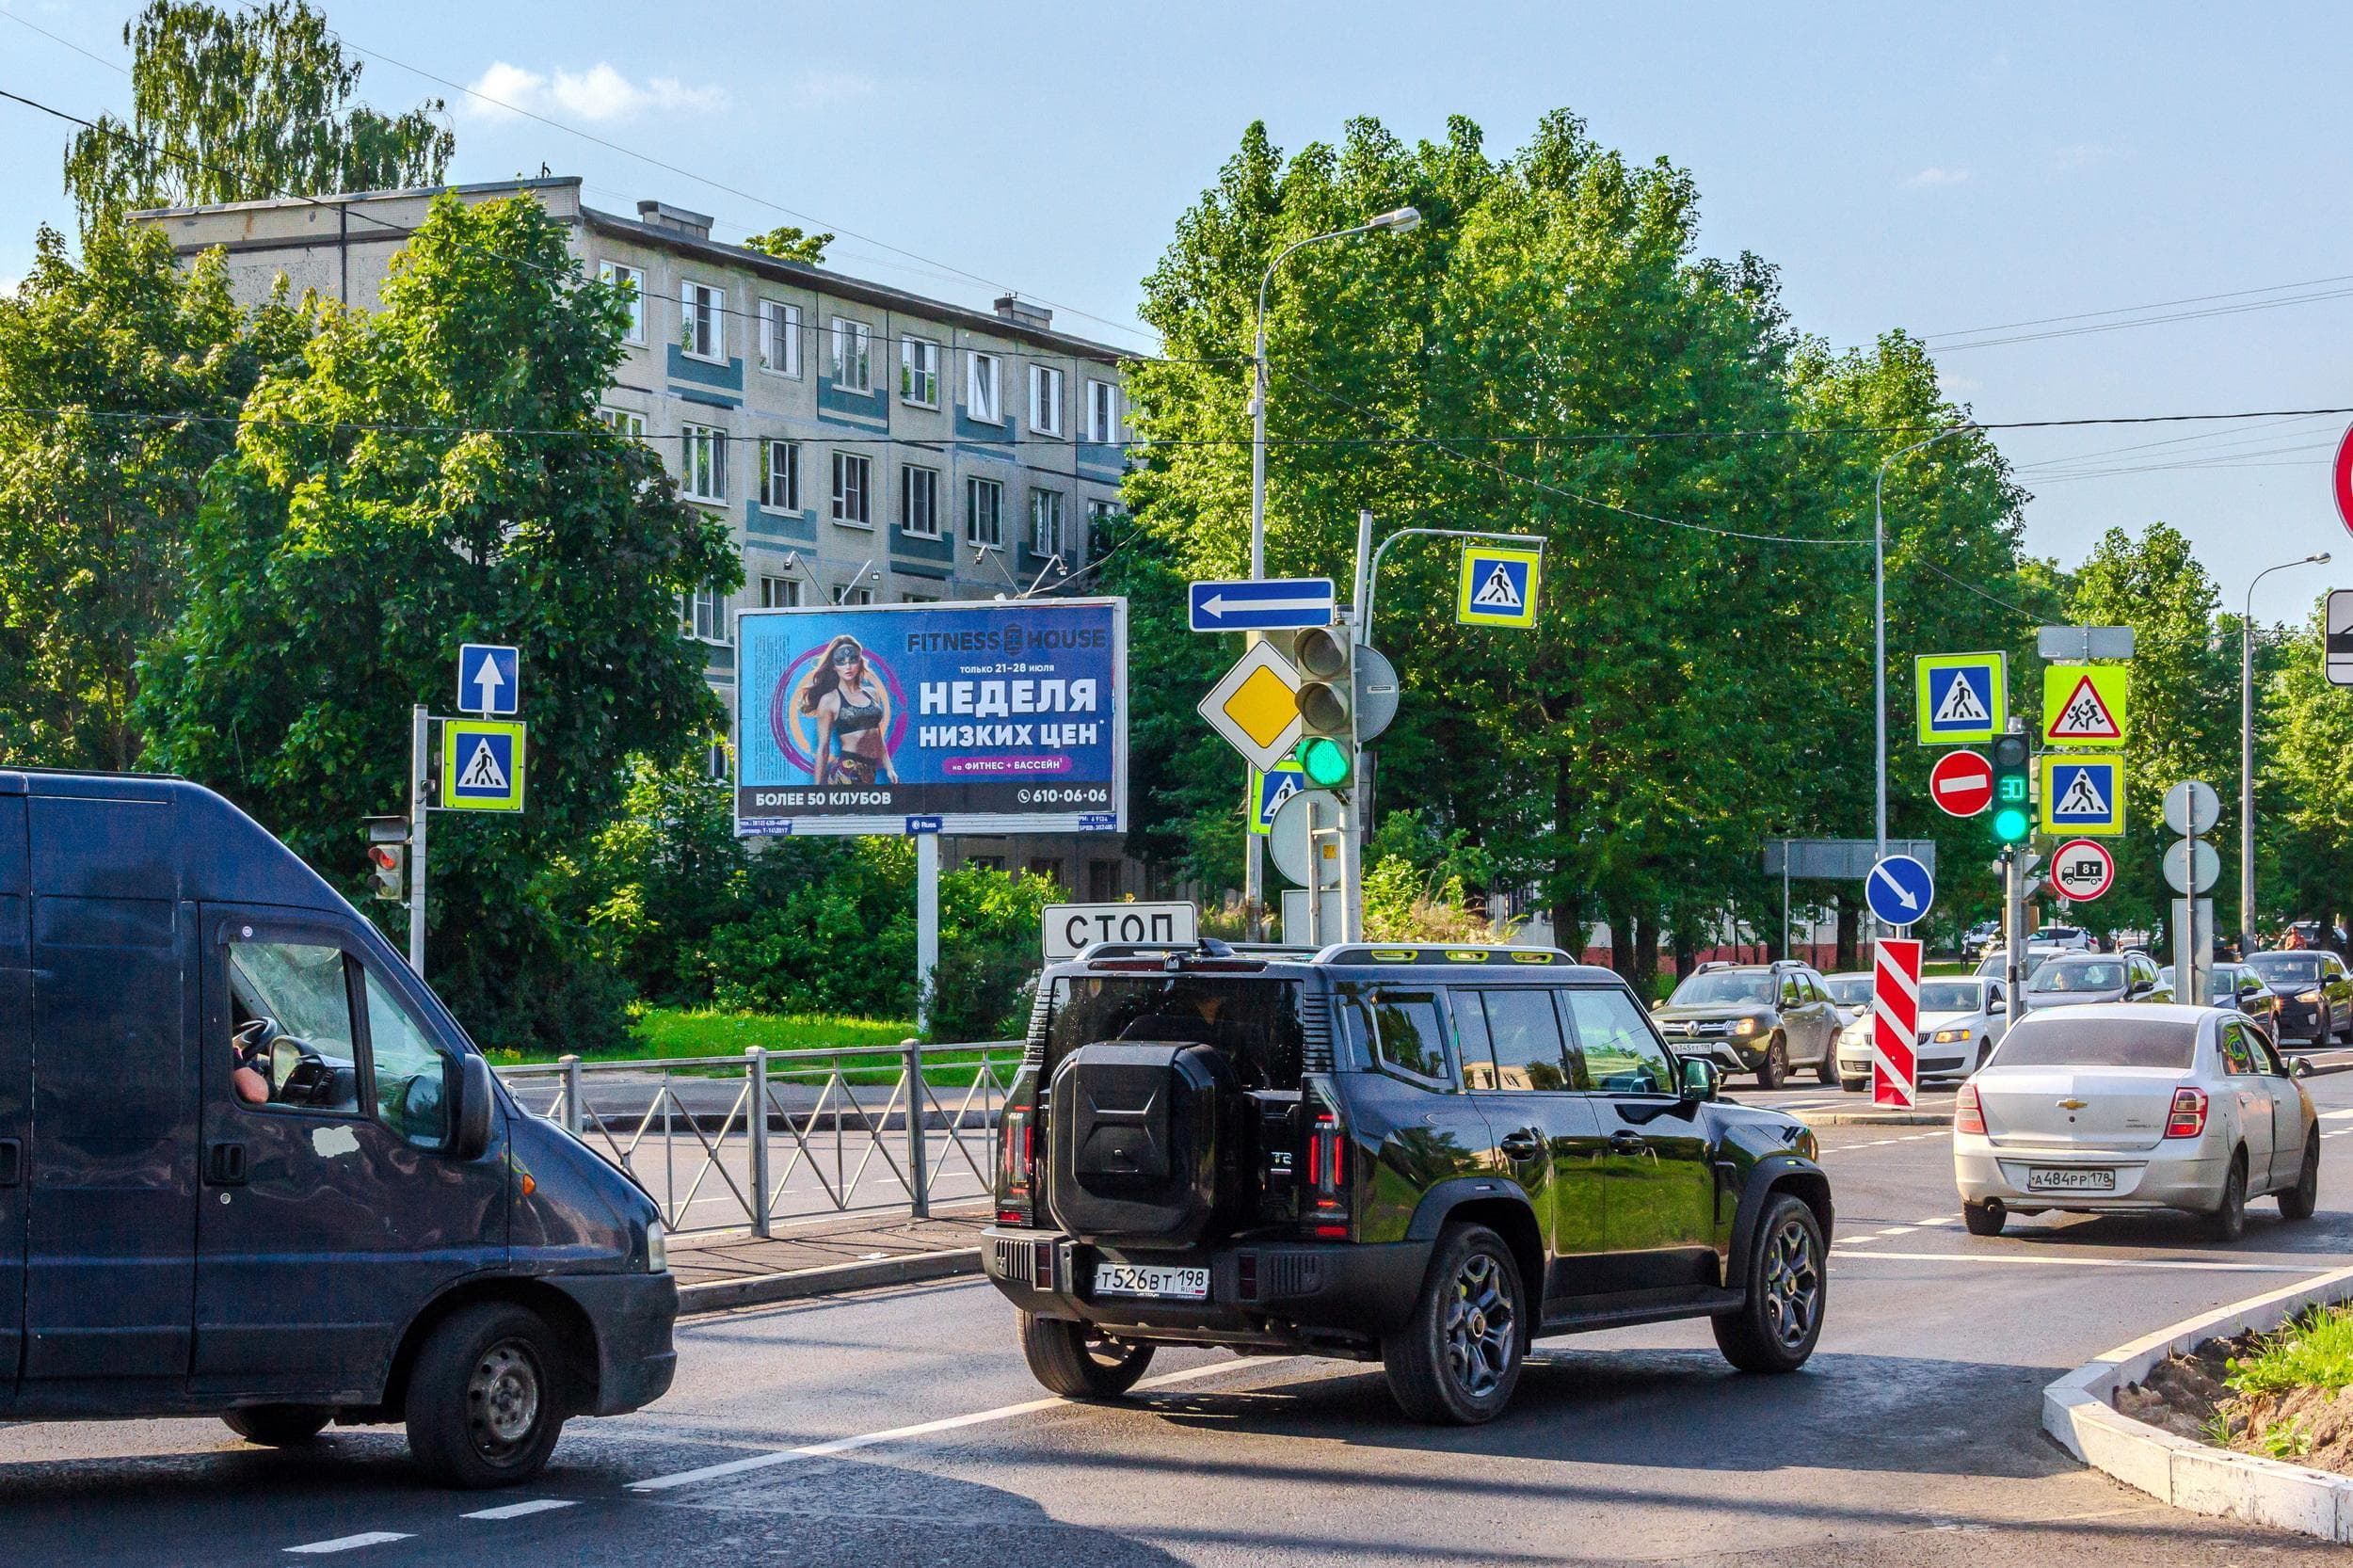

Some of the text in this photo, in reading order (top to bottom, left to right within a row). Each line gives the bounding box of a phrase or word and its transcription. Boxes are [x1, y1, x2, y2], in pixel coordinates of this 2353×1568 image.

[907, 629, 1106, 652] FITNESS HOUSE
[960, 664, 1055, 674] только 21-28 июля
[920, 679, 1096, 717] НЕДЕЛЯ
[919, 724, 1033, 747] НИЗКИХ
[965, 761, 1004, 771] ФИТНЕС
[756, 792, 891, 806] БОЛЕЕ 50 КЛУБОВ
[2002, 779, 2023, 799] 30
[1065, 914, 1173, 949] СТОП
[2090, 1172, 2109, 1183] 178
[1102, 1269, 1204, 1290] Т526ВТ 198
